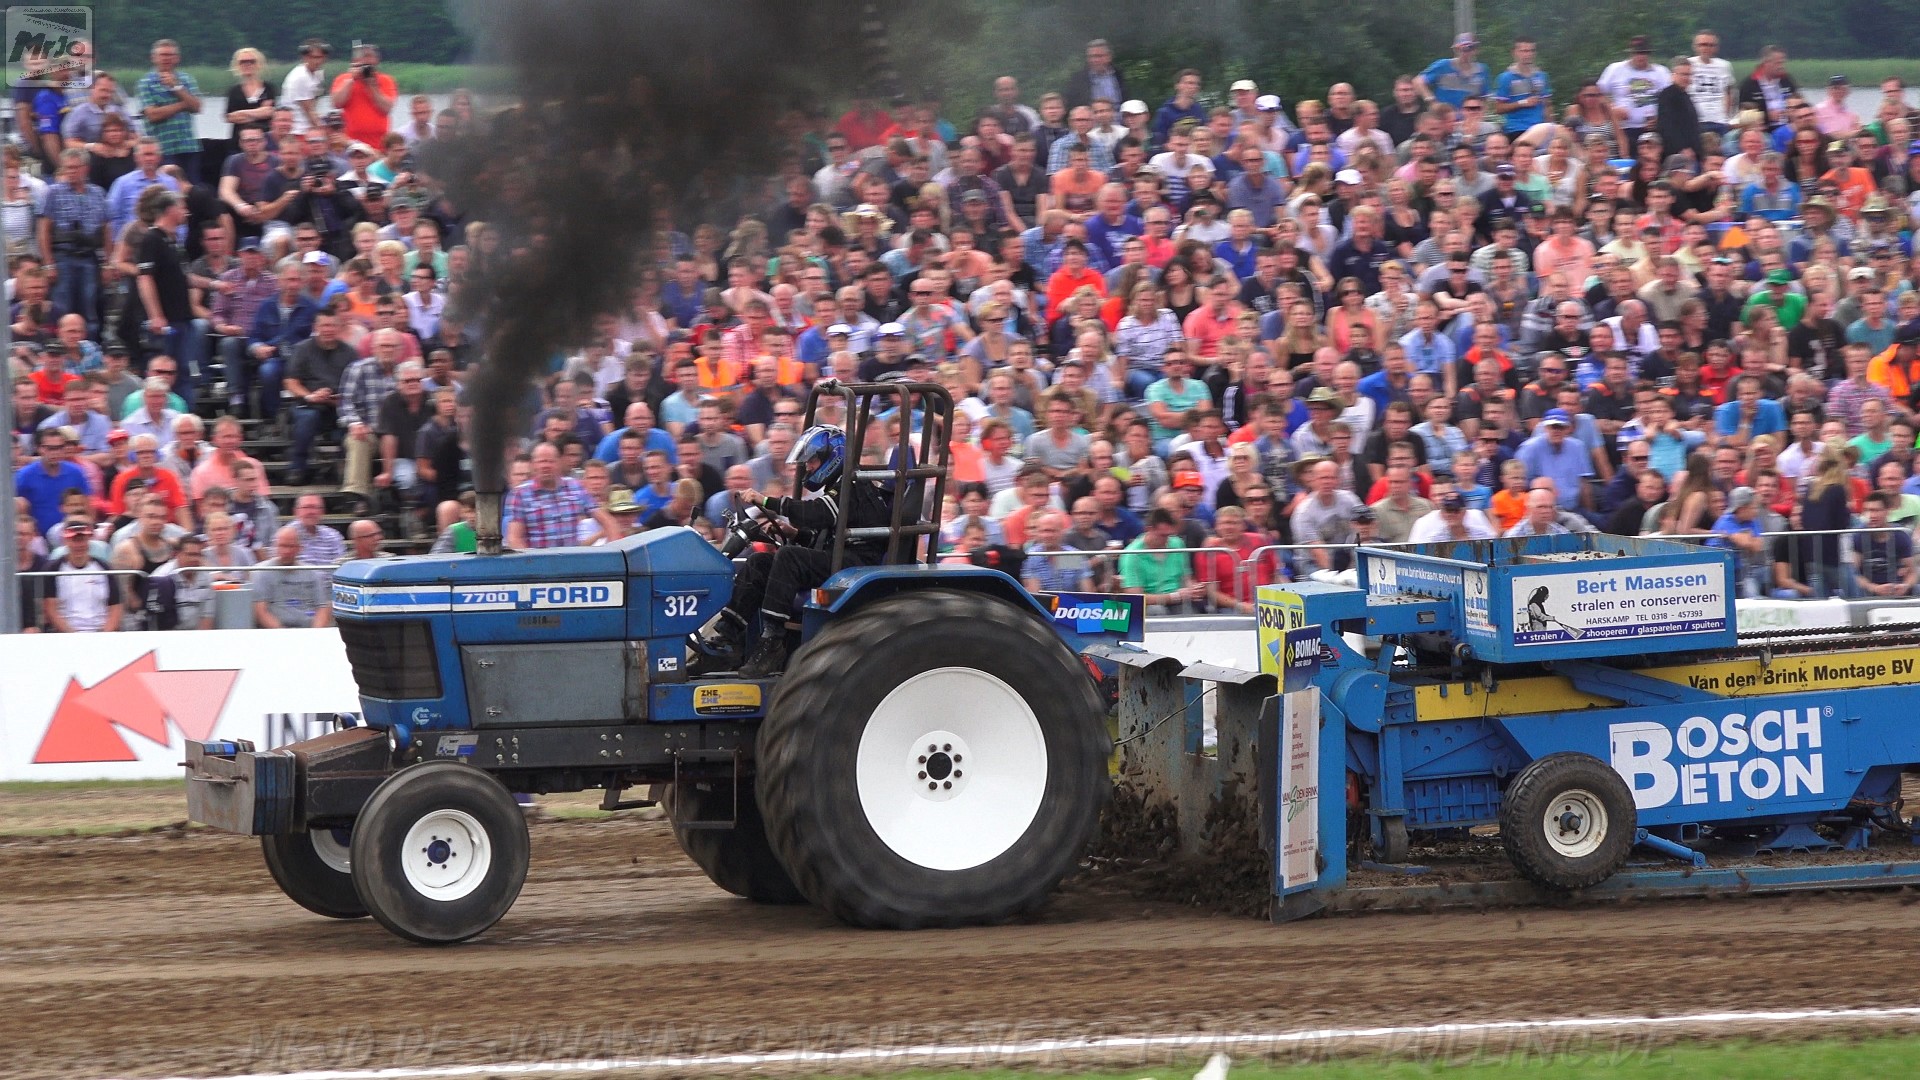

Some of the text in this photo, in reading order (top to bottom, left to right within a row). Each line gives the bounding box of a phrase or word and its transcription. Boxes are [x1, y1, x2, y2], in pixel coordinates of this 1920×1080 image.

[1577, 573, 1707, 594] Bert Maassen
[462, 586, 610, 605] 7700 FORD
[664, 595, 698, 617] 312
[1570, 593, 1717, 613] stralen en conserveren
[1054, 608, 1129, 620] DOOSAN
[1290, 611, 1303, 629] BV
[1586, 615, 1630, 625] HARSKAMP
[1636, 613, 1649, 622] TEL
[1651, 612, 1667, 621] 0318
[1677, 610, 1703, 619] 457393
[1530, 633, 1557, 641] stralen
[1586, 628, 1628, 639] shooperen
[1637, 623, 1682, 636] glasparelen
[1691, 620, 1720, 631] spuiten
[1295, 637, 1321, 658] BOMAG
[1689, 659, 1914, 690] Van den Brink Montage BV
[1609, 707, 1822, 810] BOSCH
